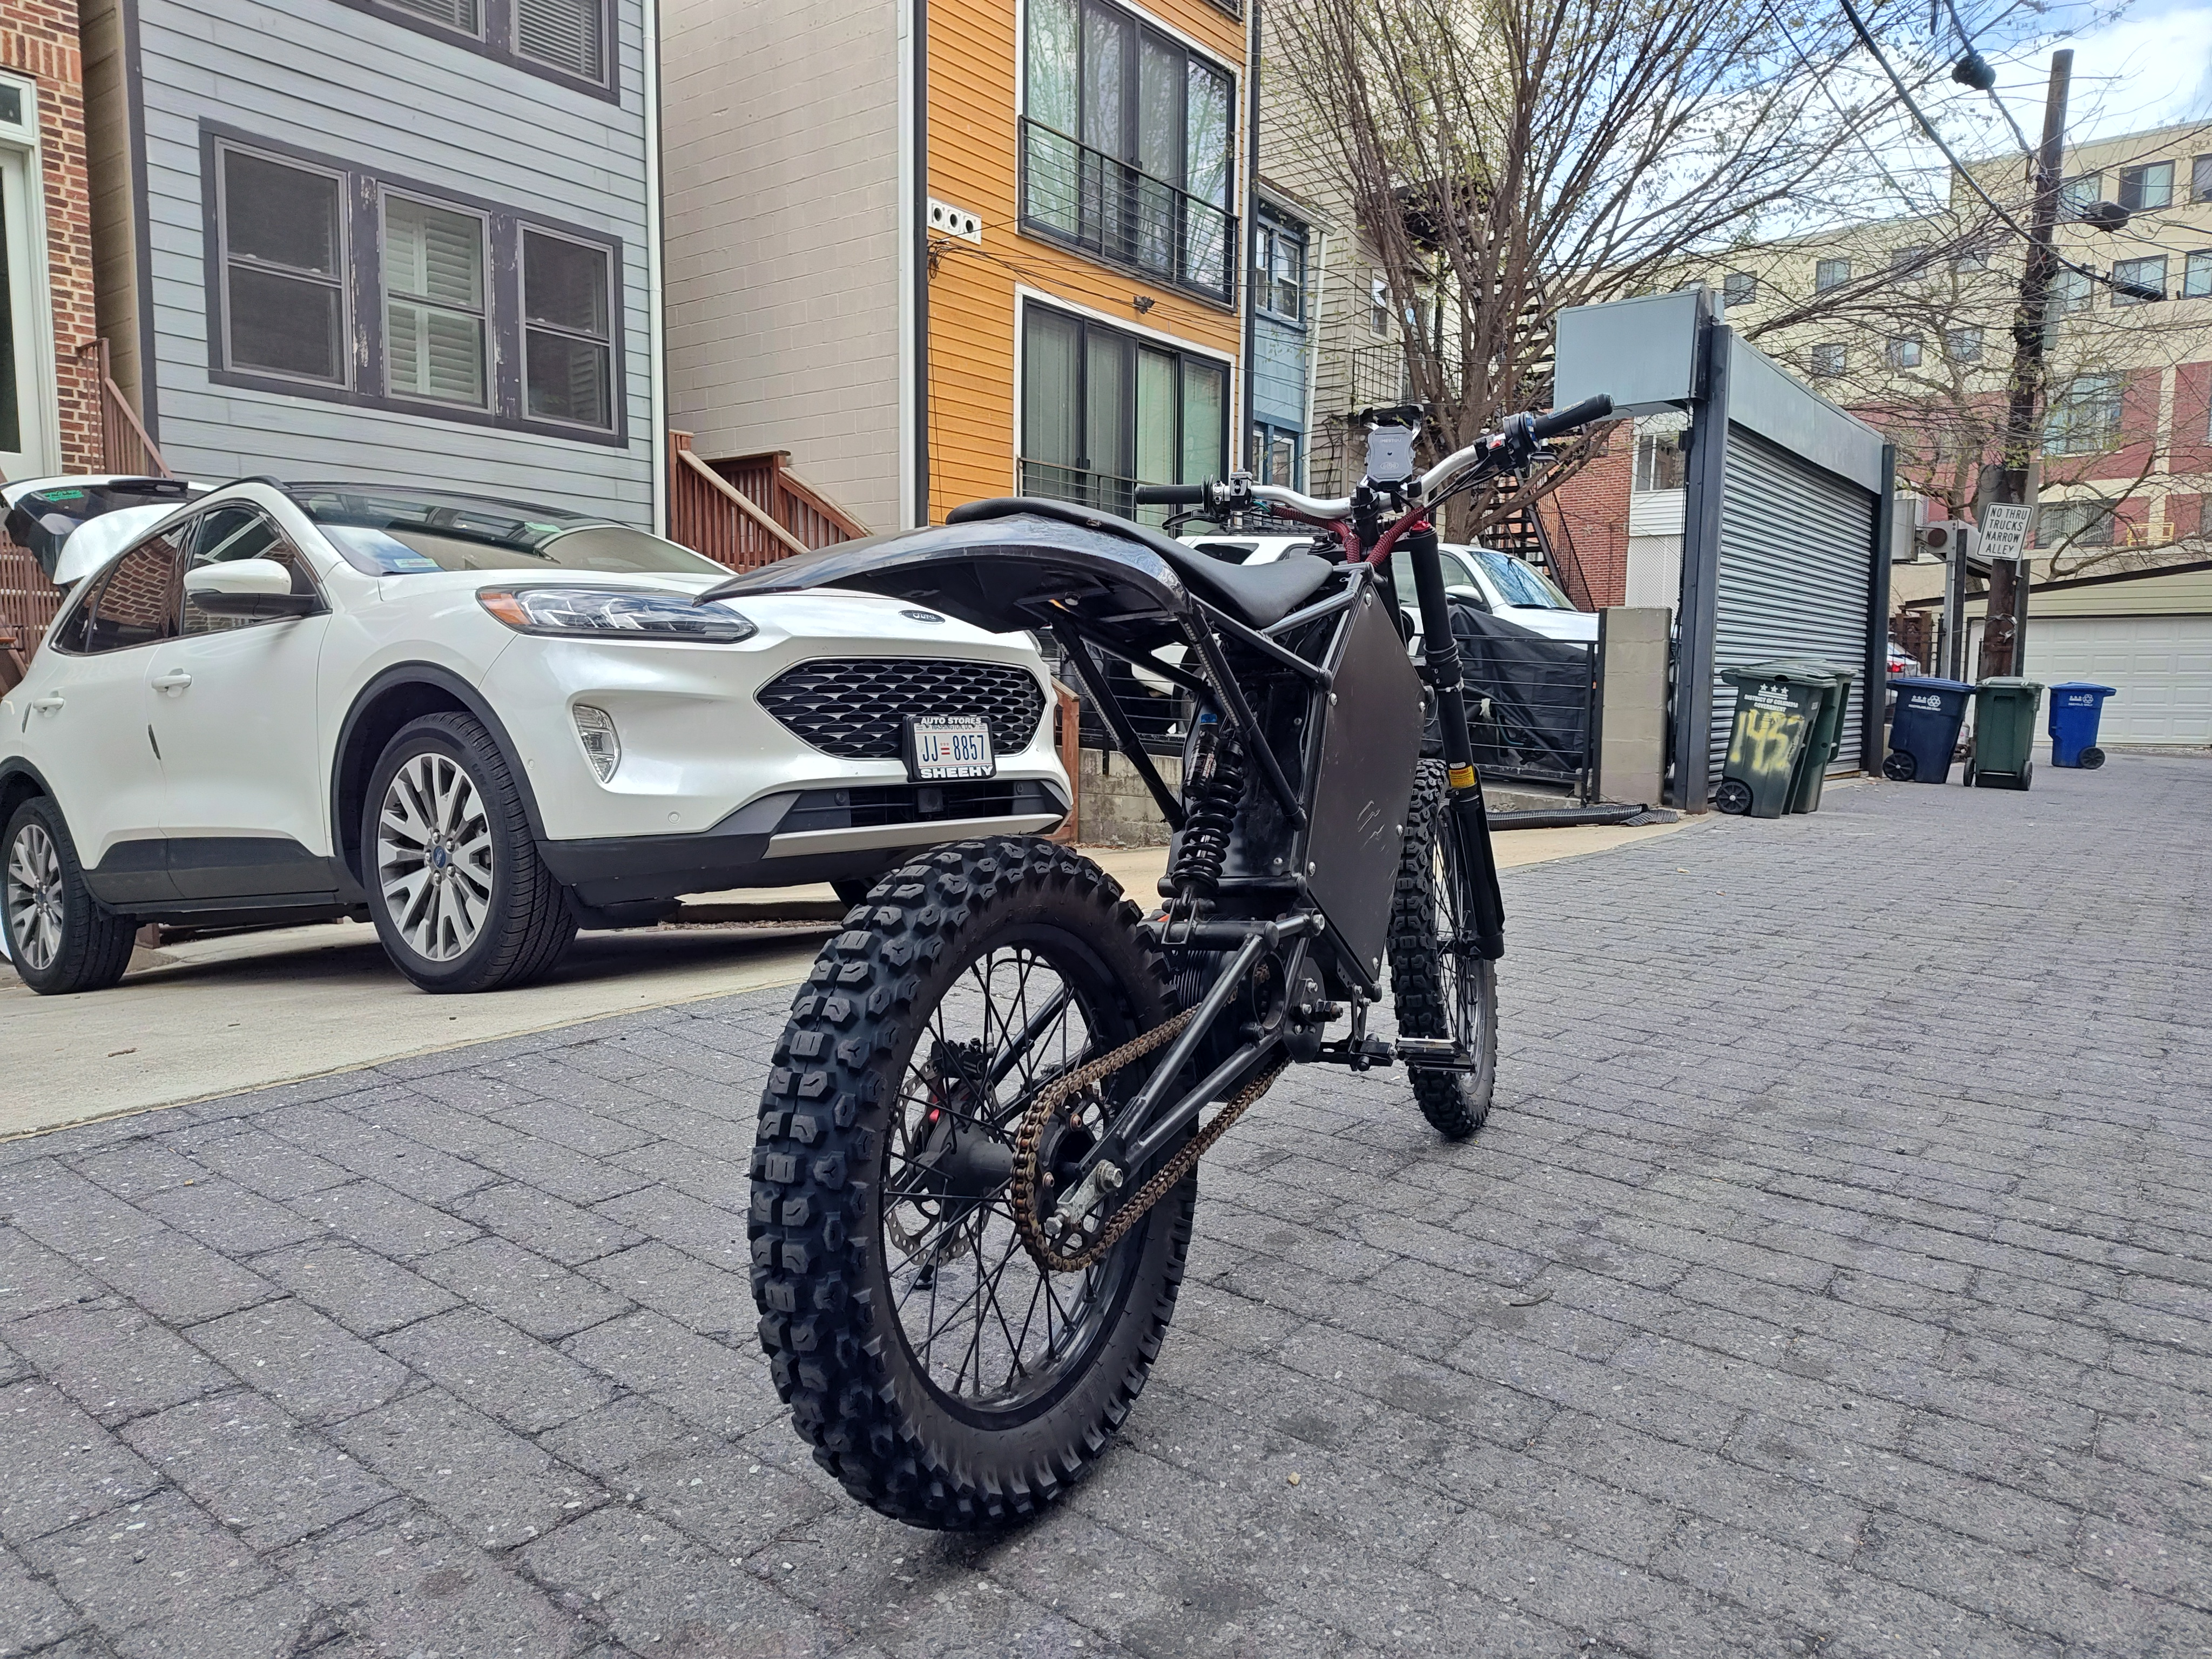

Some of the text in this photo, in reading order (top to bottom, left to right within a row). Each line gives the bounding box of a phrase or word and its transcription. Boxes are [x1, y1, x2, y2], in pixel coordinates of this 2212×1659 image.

[1990, 508, 2028, 520] NO THRU
[1990, 519, 2024, 531] TRUCKS
[1985, 531, 2020, 543] NARROW
[1985, 543, 2015, 555] ALLEY
[1744, 694, 1766, 703] DISTRICT
[1773, 699, 1799, 708] COLUMBIA
[1754, 702, 1787, 712] GOVERNMENT
[920, 766, 993, 779] SHEEHY
